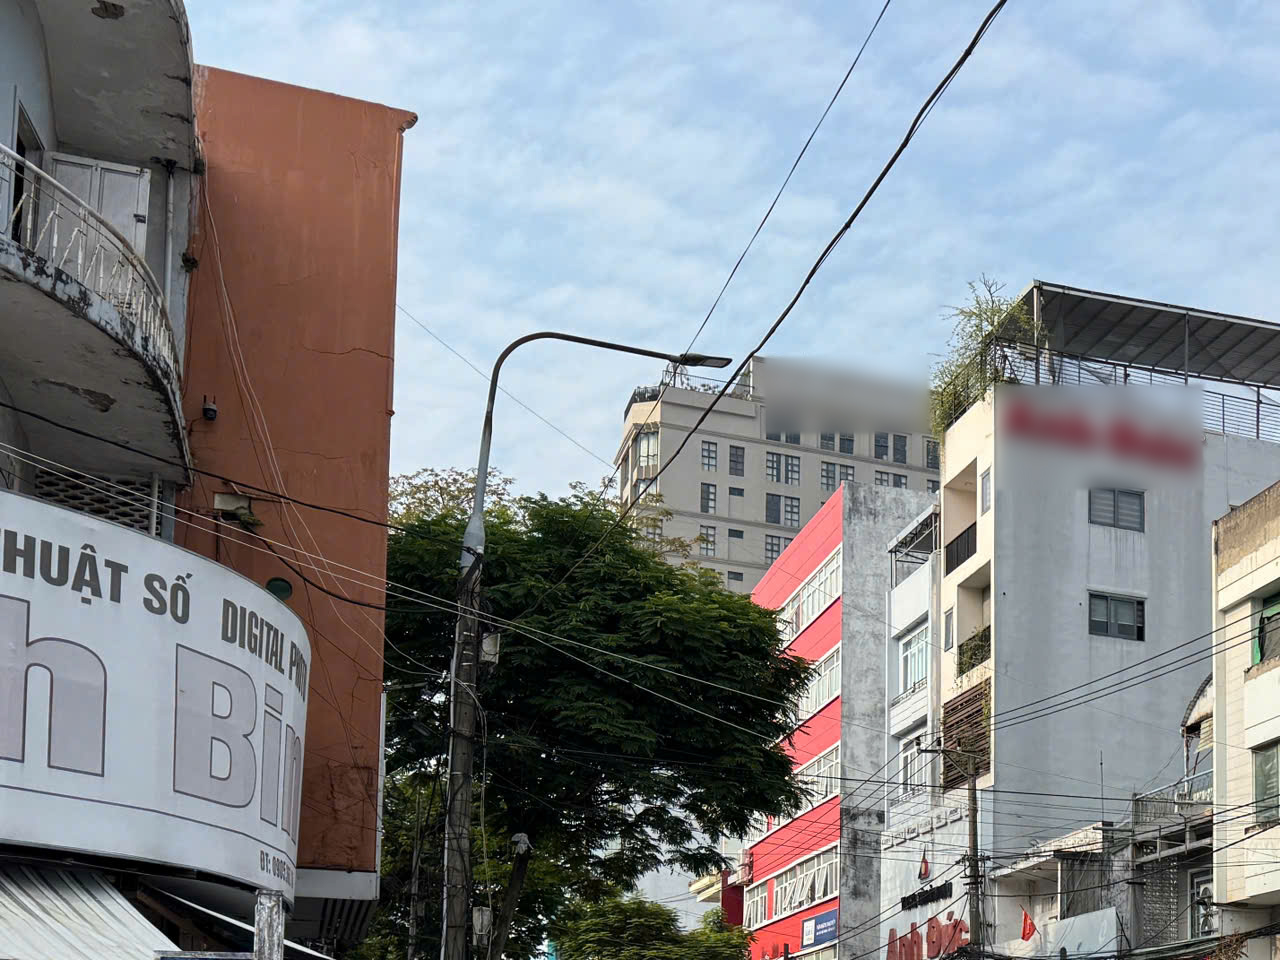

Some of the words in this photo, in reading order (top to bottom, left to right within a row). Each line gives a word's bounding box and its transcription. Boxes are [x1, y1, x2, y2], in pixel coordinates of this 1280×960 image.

[0, 528, 129, 605] HUẬT
[143, 572, 193, 624] SỐ
[221, 598, 285, 675] DIGITAL
